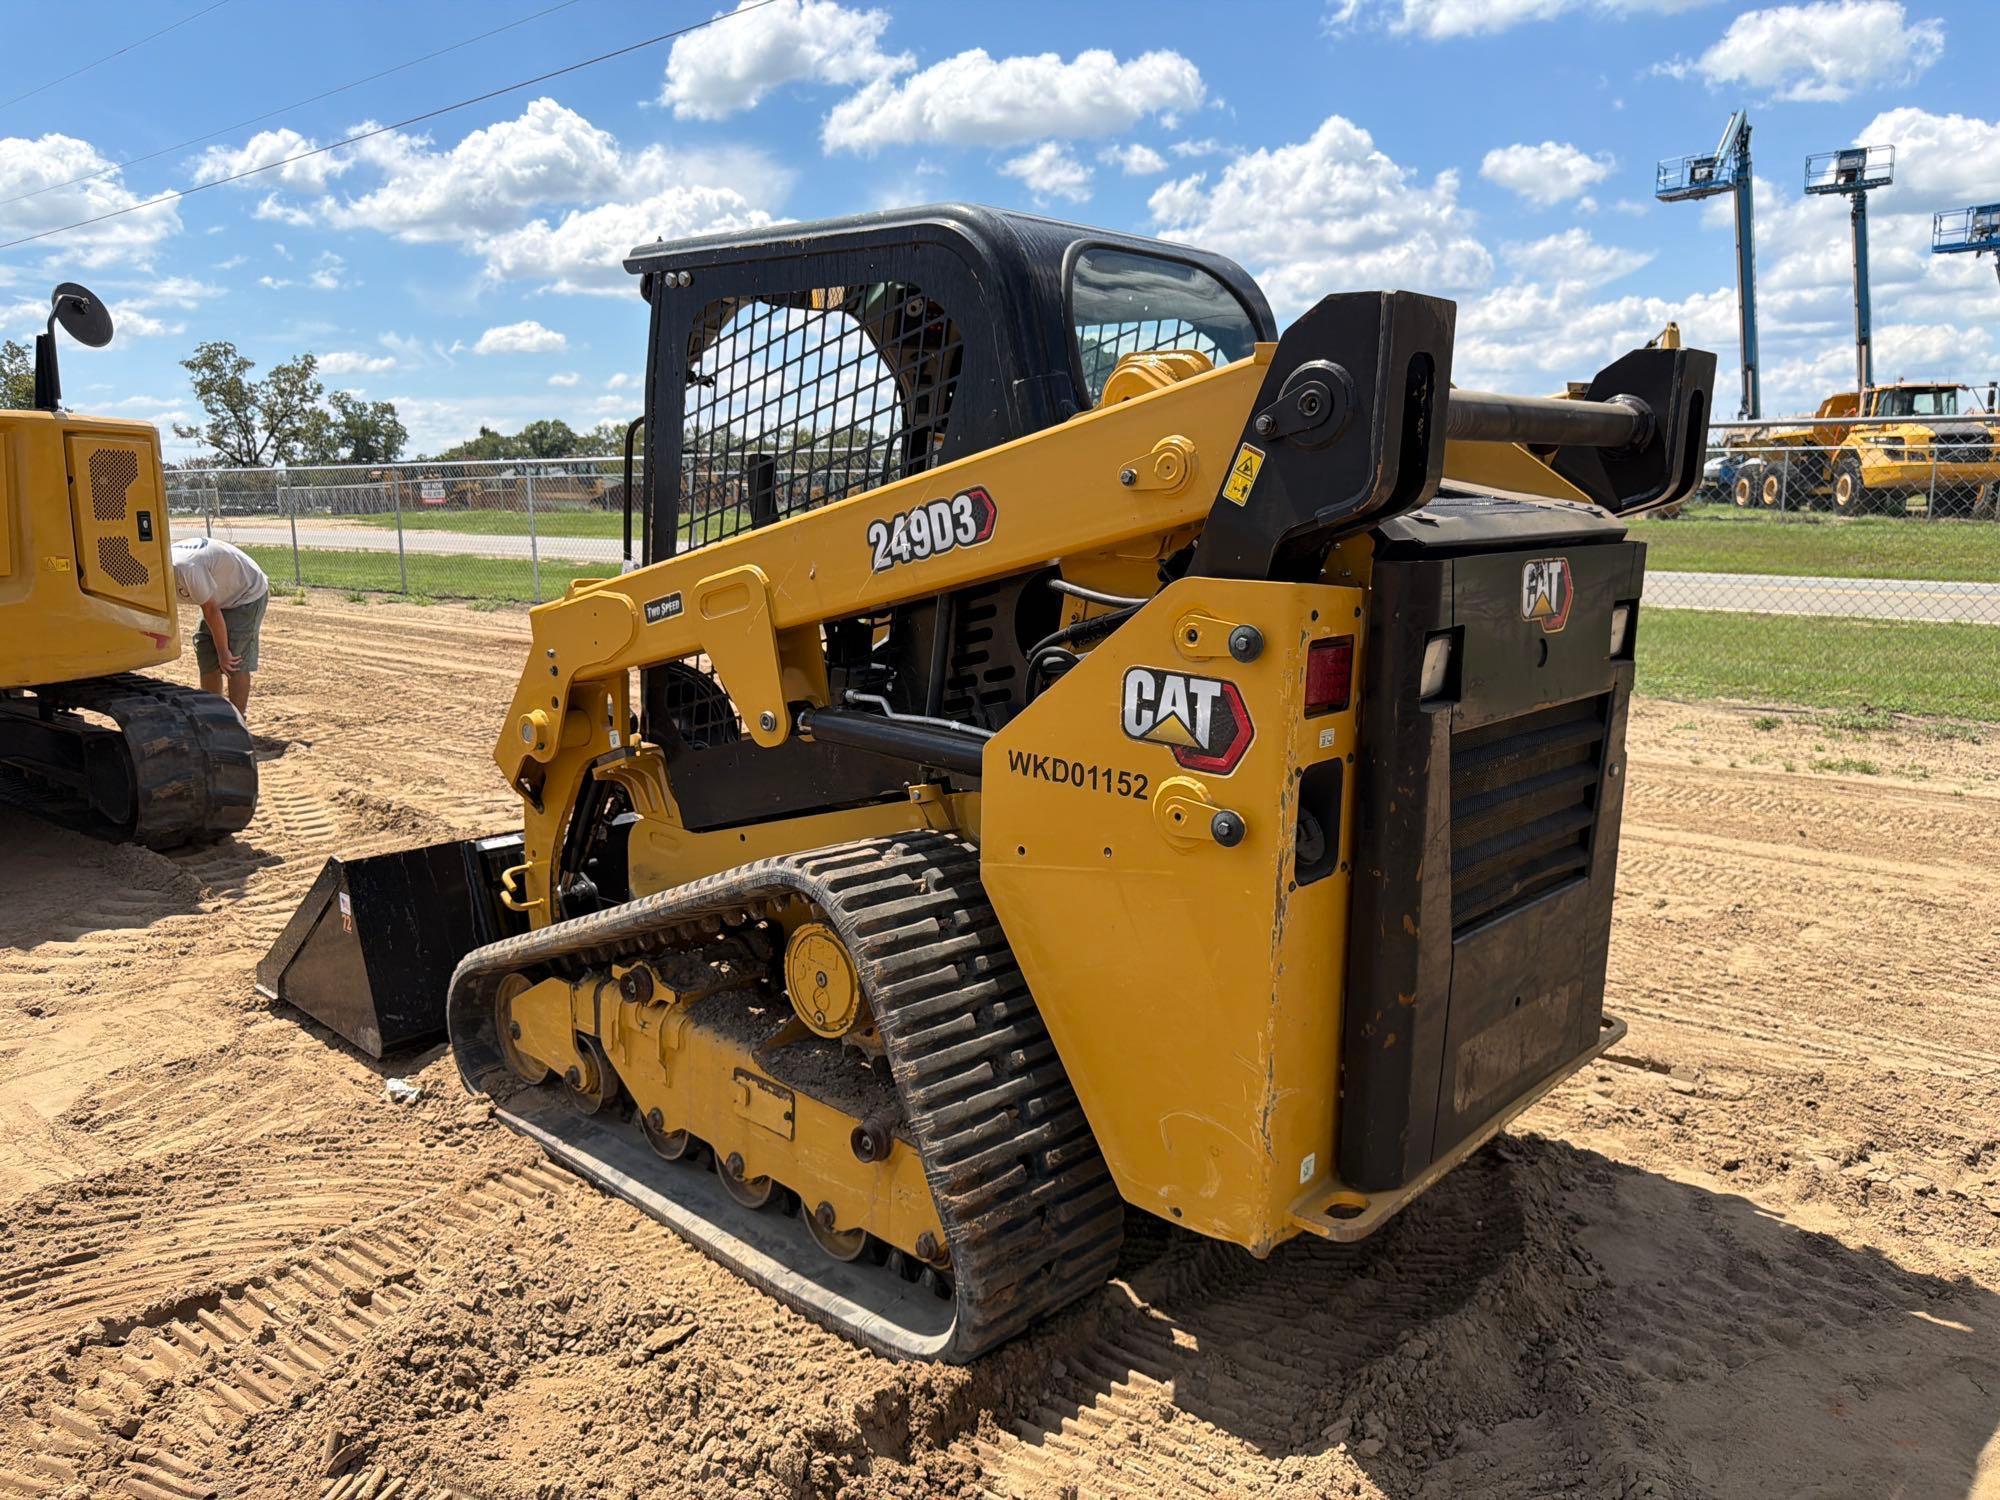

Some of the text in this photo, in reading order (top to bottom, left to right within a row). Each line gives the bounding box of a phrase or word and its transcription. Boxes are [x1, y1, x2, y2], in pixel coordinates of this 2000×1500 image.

[868, 494, 977, 570] 249D3
[1522, 561, 1562, 618] CAT
[1124, 668, 1222, 749] CAT
[1008, 749, 1149, 801] WKD01152
